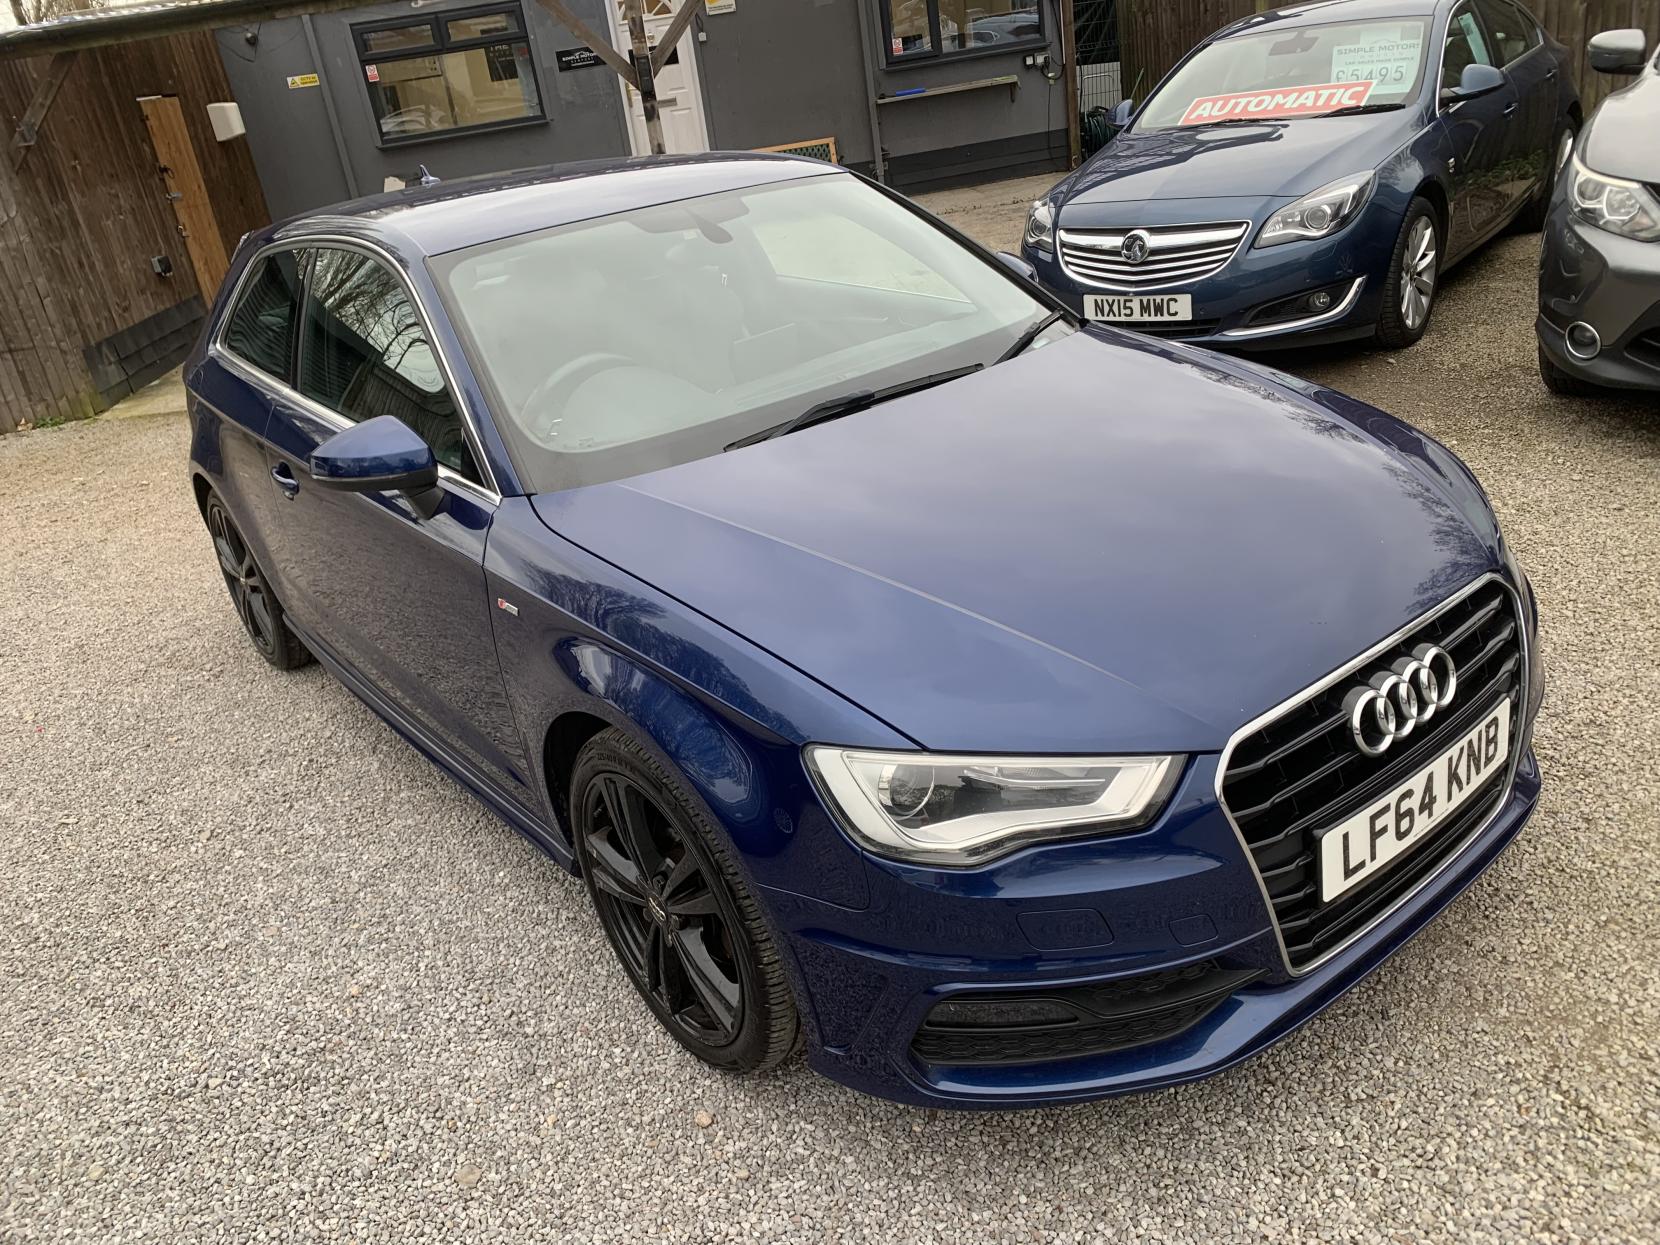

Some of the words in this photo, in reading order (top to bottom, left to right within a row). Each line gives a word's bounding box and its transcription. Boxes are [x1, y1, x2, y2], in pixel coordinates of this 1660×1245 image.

[1337, 46, 1375, 55] SIMPLE
[1190, 87, 1365, 119] AUTOMATIC
[1094, 298, 1134, 317] NX15
[1140, 298, 1179, 317] MWC
[1342, 771, 1437, 882] LF64
[1447, 716, 1500, 804] KNB
